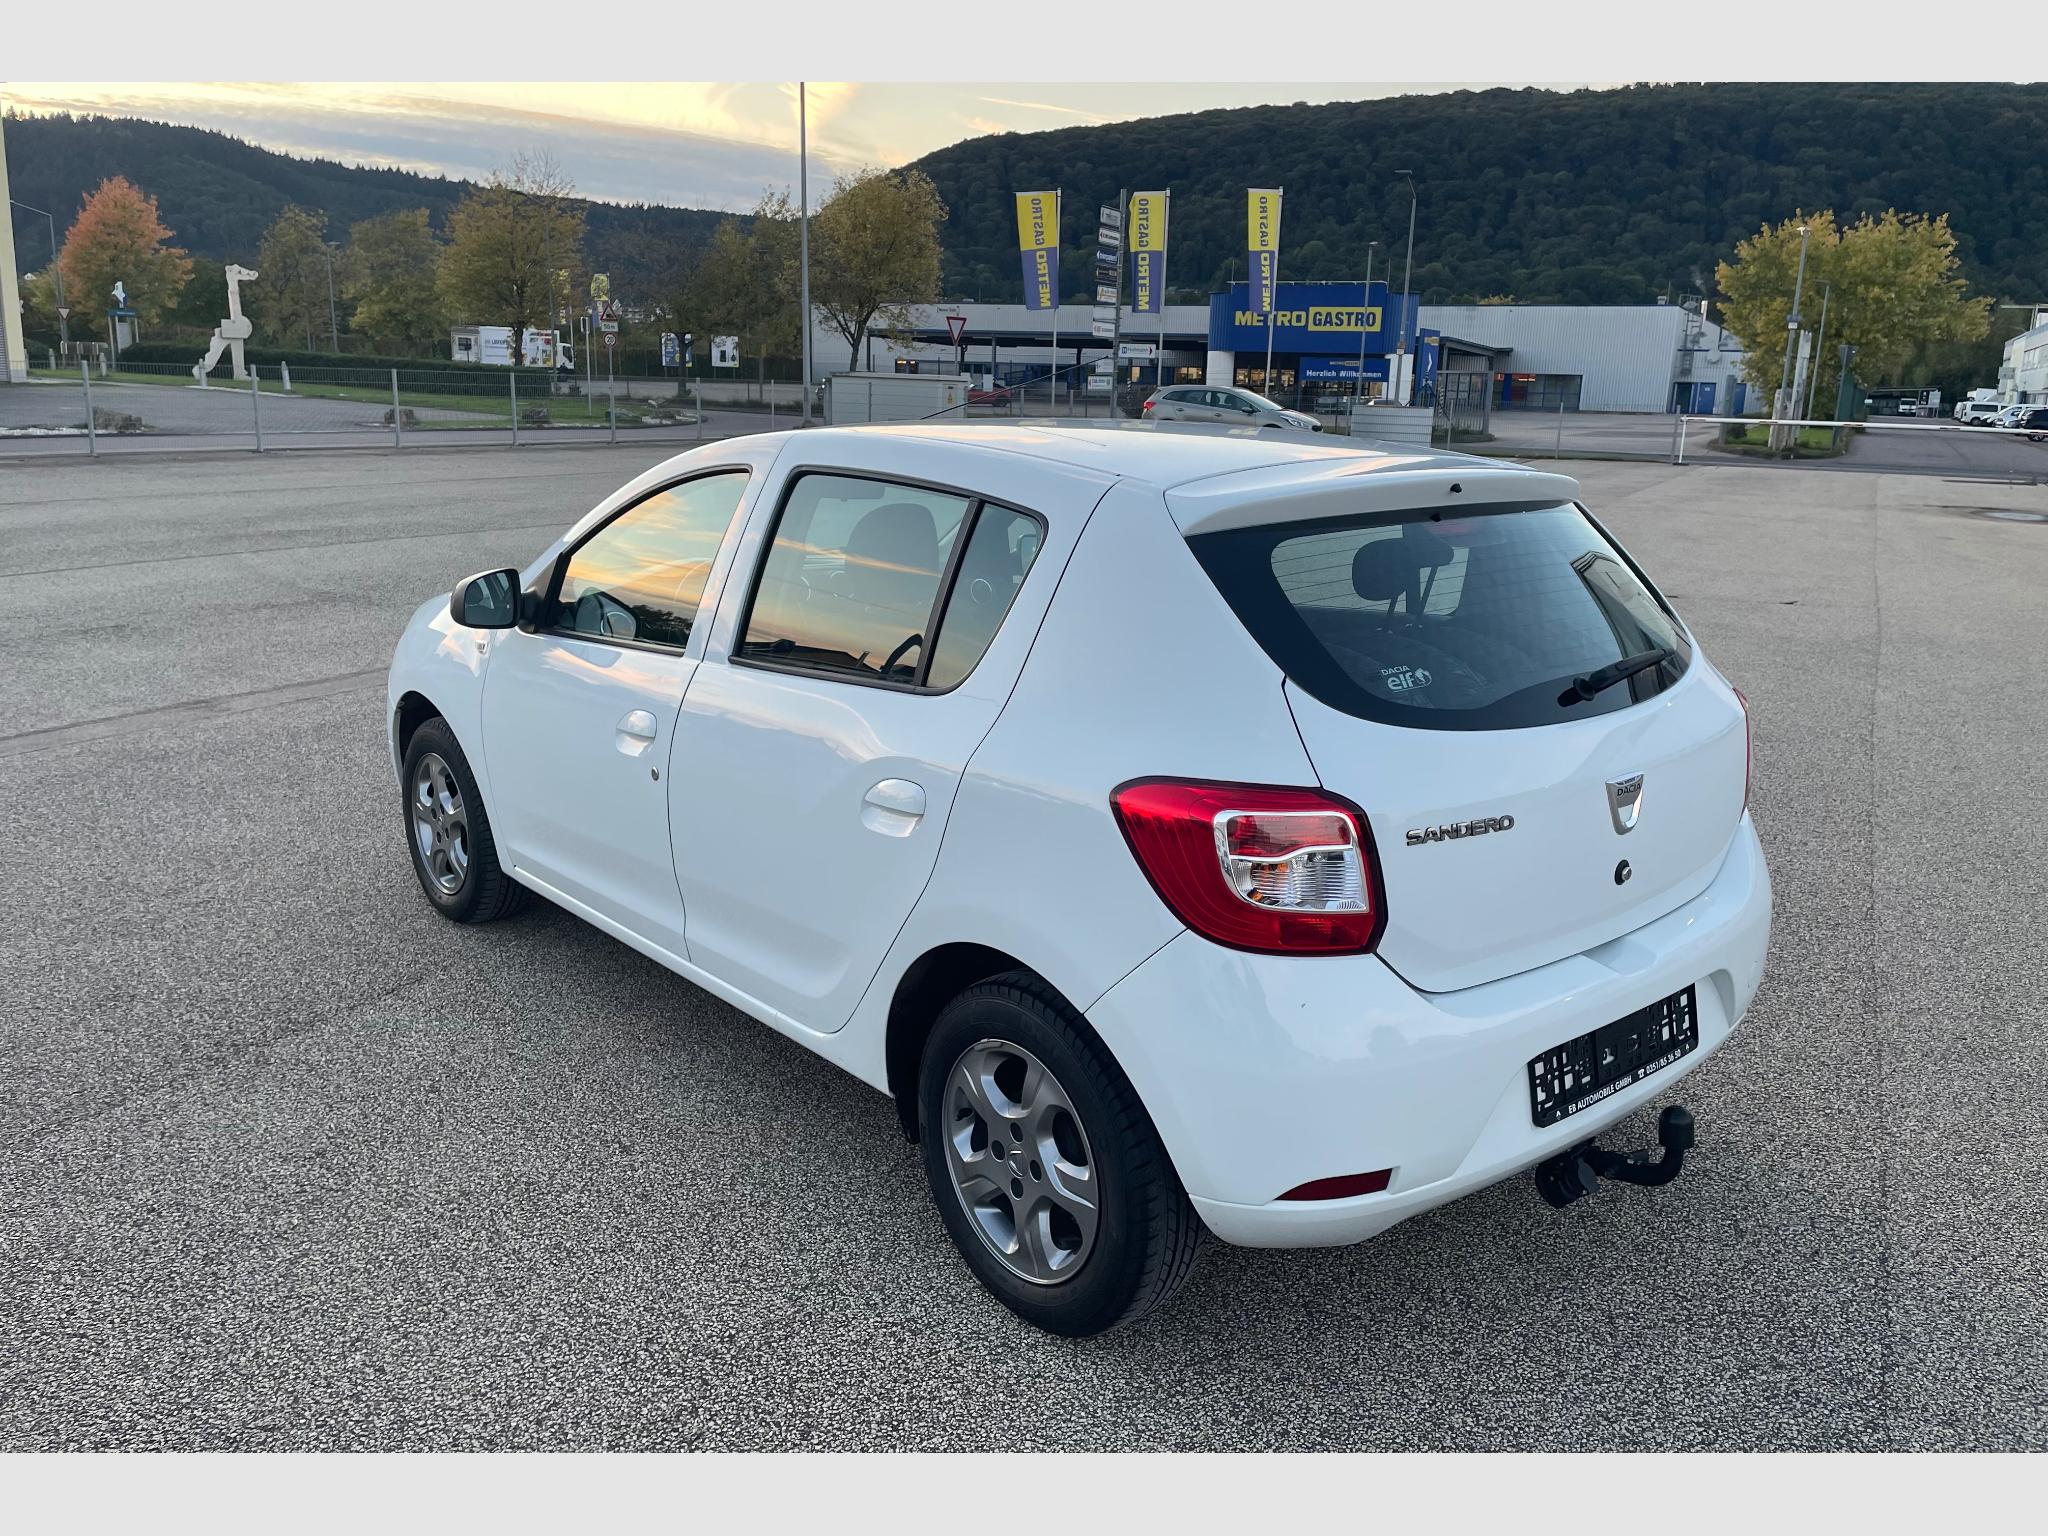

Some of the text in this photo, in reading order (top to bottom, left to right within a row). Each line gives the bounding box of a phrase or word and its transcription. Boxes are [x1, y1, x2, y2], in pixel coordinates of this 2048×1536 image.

[1312, 311, 1377, 328] GASTRO
[1306, 369, 1337, 378] Herzlich
[1381, 665, 1410, 676] DACIA
[1387, 672, 1414, 690] elf
[1617, 783, 1641, 796] DACIA
[1406, 815, 1515, 847] SANDERO
[1577, 1084, 1615, 1110] AUTOMOBILE
[1615, 1075, 1632, 1090] GMBH
